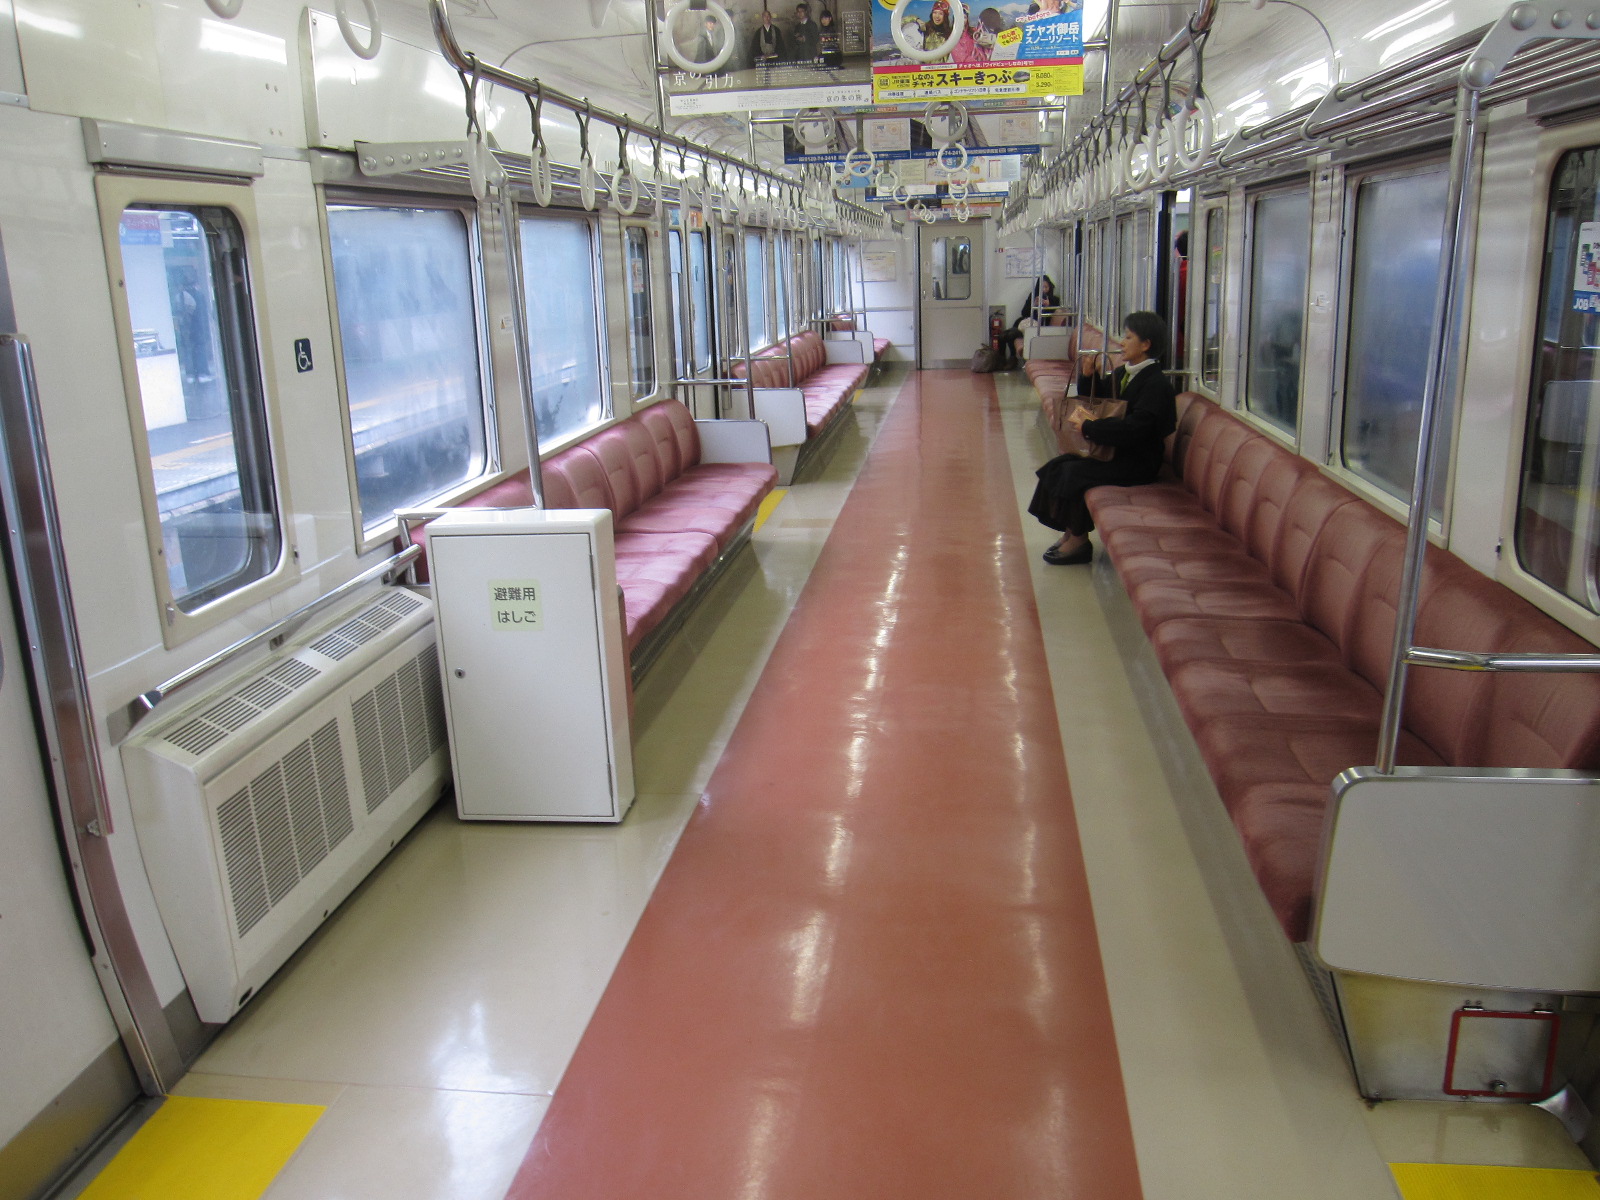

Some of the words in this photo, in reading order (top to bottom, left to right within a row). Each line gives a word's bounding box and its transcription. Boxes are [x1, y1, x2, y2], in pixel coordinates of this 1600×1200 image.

[1025, 22, 1080, 36] チャオ御岳
[1025, 35, 1079, 44] スノーリゾート
[912, 80, 934, 88] チャオ
[494, 587, 536, 601] 避難用
[497, 610, 537, 624] はしご
